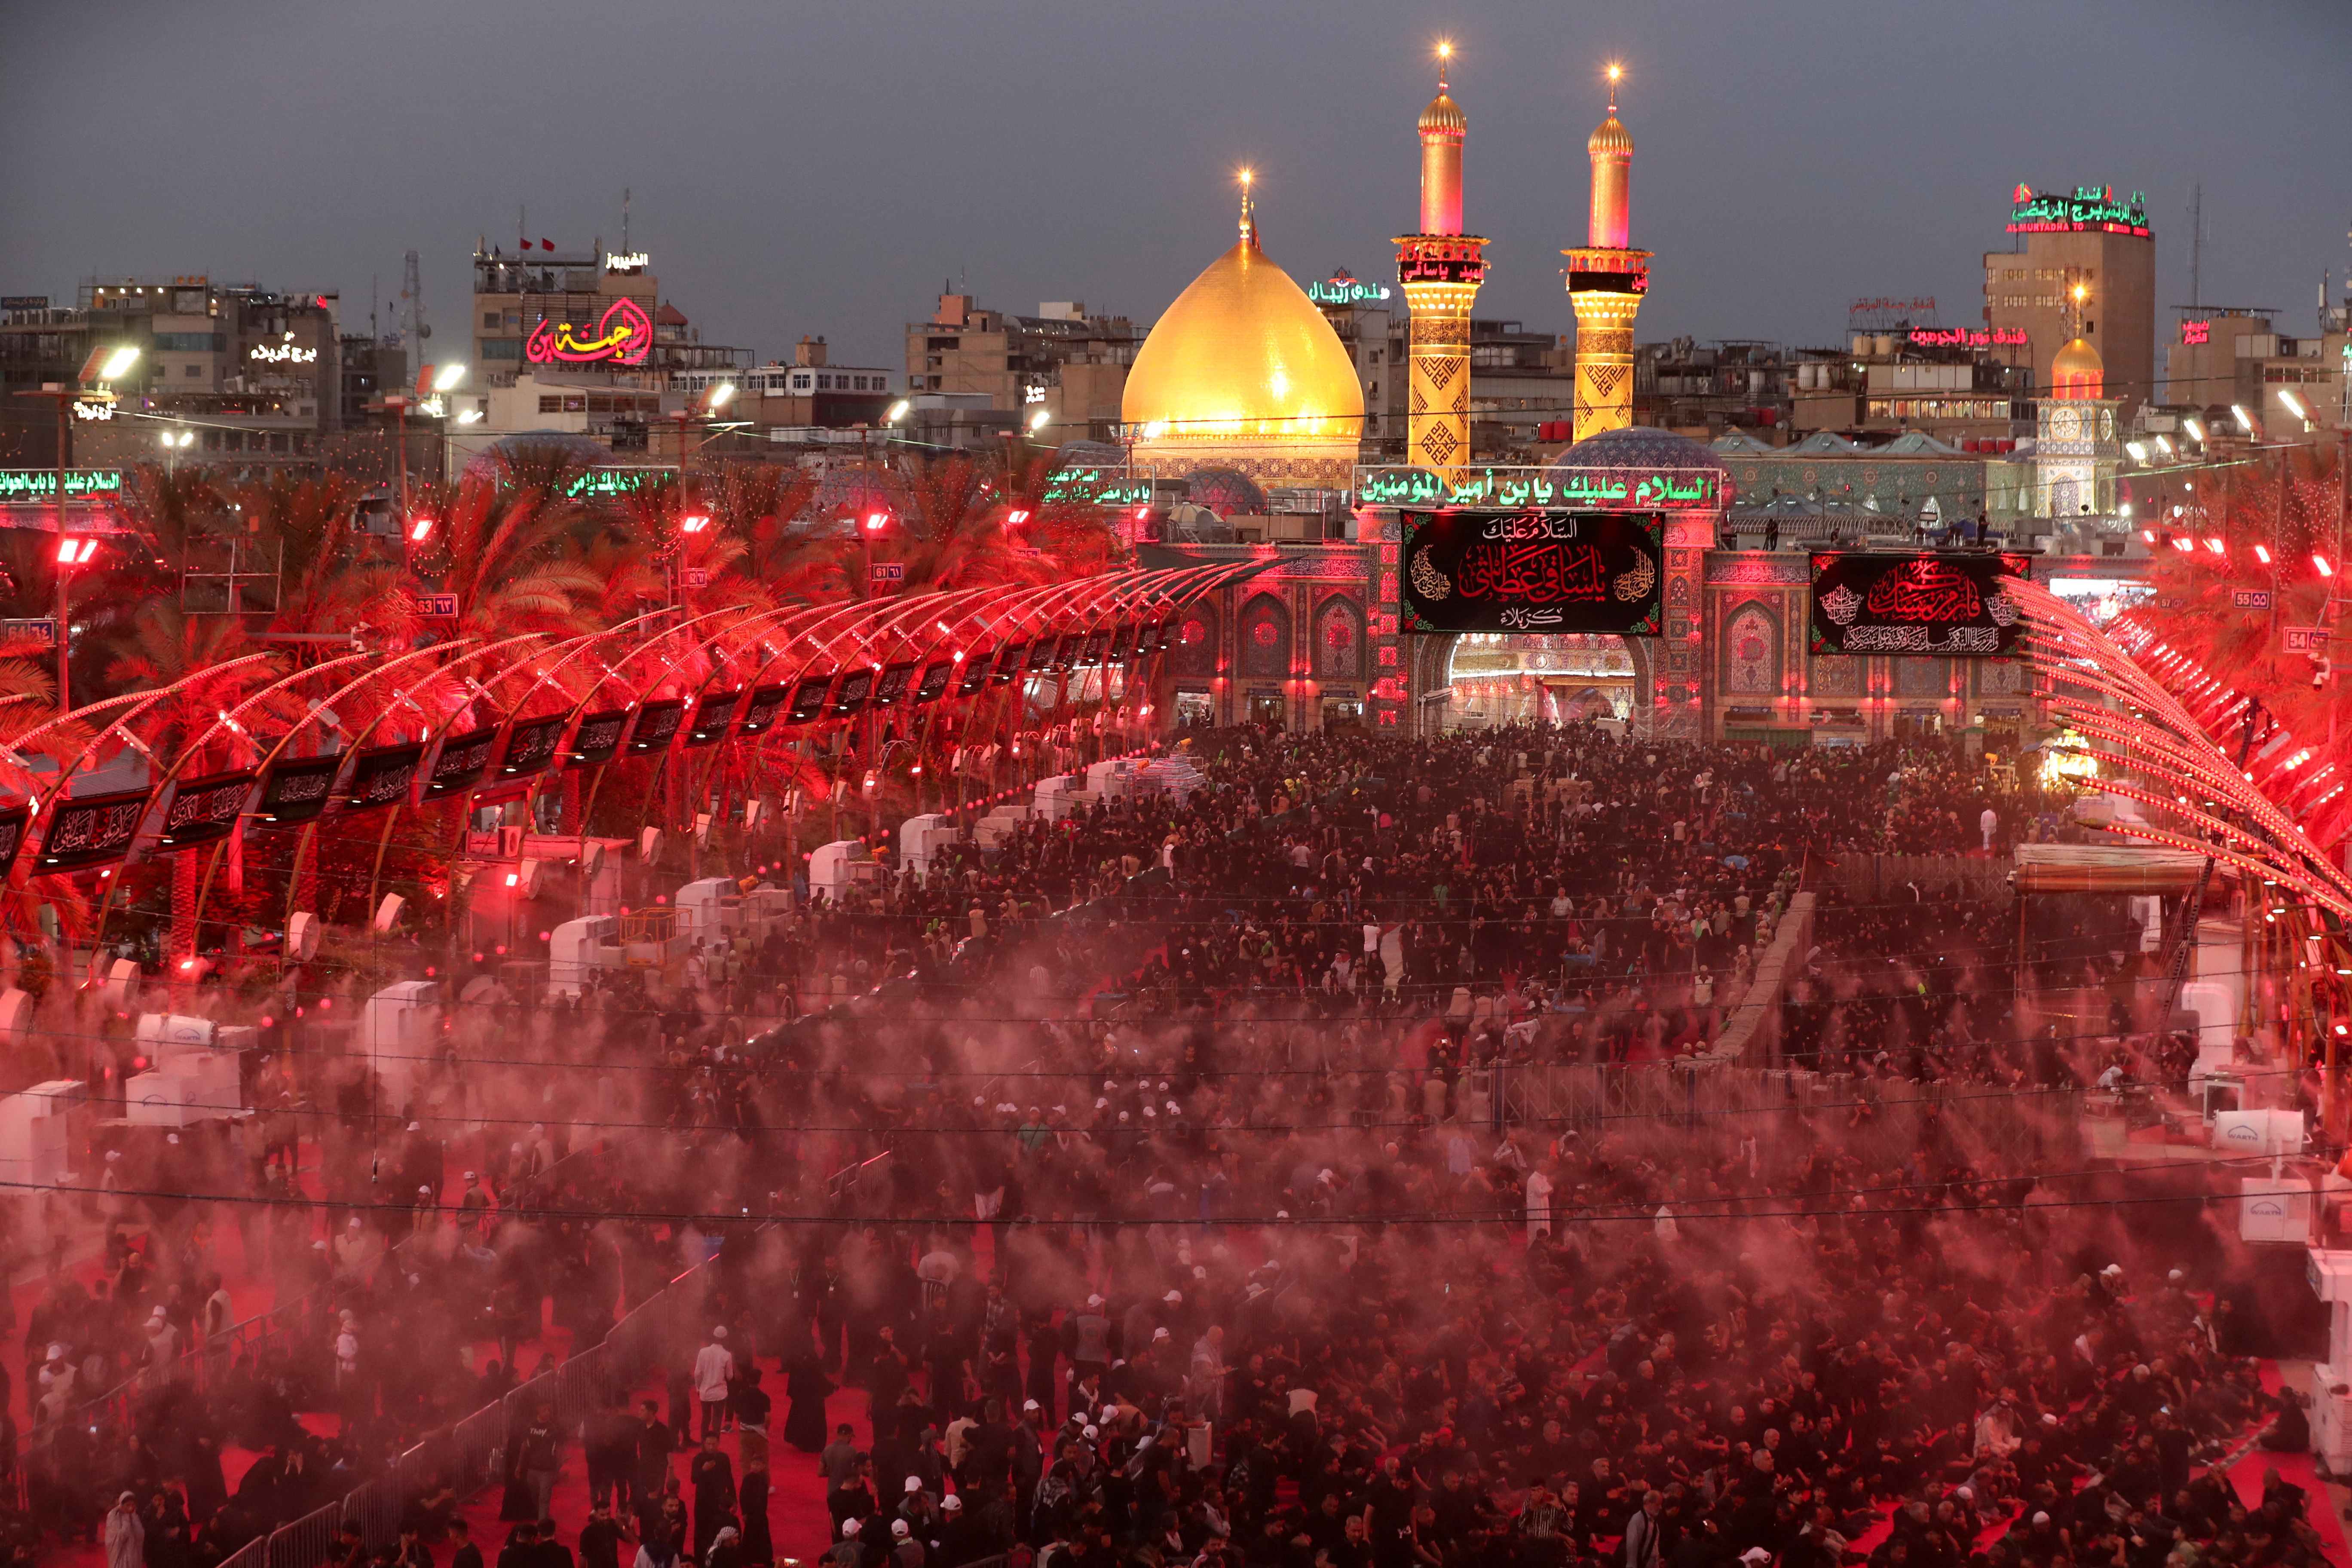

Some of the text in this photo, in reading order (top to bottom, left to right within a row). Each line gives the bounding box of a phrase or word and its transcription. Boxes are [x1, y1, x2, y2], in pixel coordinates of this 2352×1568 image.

[2074, 187, 2101, 201] فندق
[2012, 199, 2103, 222] برج المرتضى
[606, 252, 648, 270] الفيروز
[1910, 326, 2027, 346] فندق نور الحرمين
[0, 472, 28, 495] الحوائ
[28, 472, 47, 495] باب
[48, 472, 56, 495] يا
[86, 472, 120, 494] السلام
[1071, 468, 1098, 483] السلام
[1446, 468, 1494, 503] أمير
[1141, 485, 1150, 504] يا
[1362, 472, 1442, 502] المؤمنين
[1563, 476, 1628, 505] عليك
[1635, 475, 1712, 505] السلام
[689, 572, 696, 583] 62
[876, 567, 899, 577] 61 ٦١
[417, 599, 451, 613] 63 ٦٣
[2237, 593, 2267, 606] 55 ٥٥
[1501, 607, 1563, 630] كربلاء
[2290, 633, 2306, 648] 54
